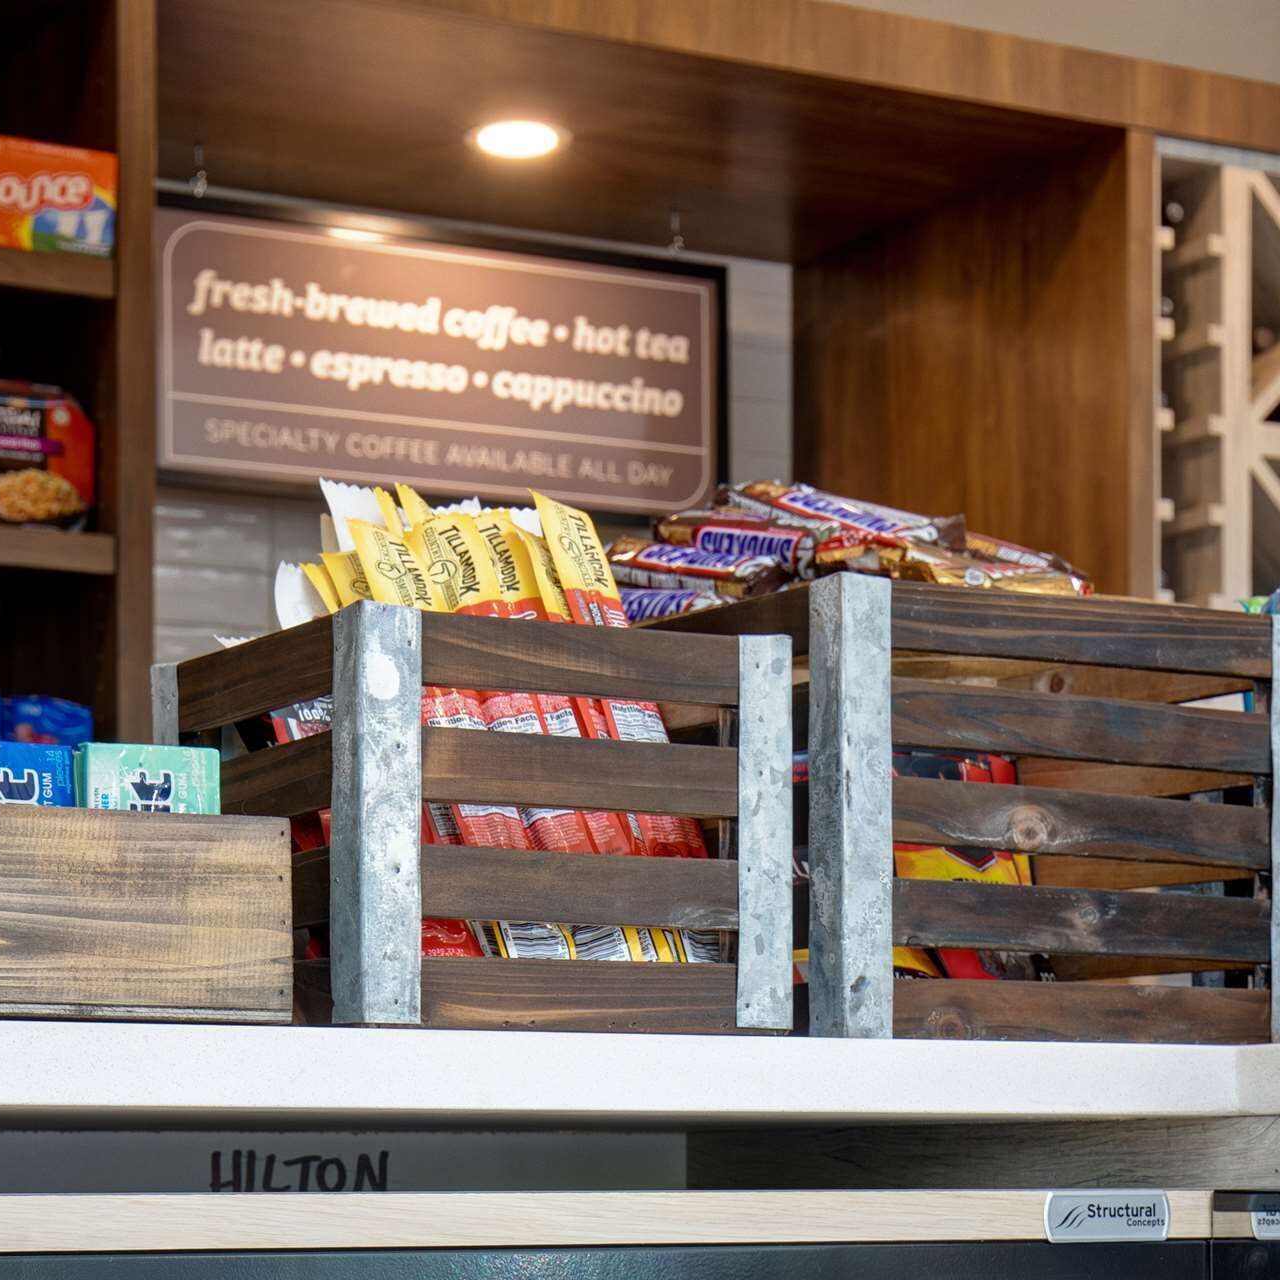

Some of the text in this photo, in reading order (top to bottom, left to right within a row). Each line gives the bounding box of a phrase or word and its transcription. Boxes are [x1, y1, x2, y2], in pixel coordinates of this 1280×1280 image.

[188, 269, 690, 364] fresh-brewed coffee hot tea
[198, 328, 683, 419] latte espresso cappuccino
[204, 416, 674, 487] SPECIALTY COFFEE AVAILABLE ALL DAY
[440, 525, 480, 596] TILLAMOOK
[480, 524, 519, 592] TILLAMOOK
[568, 514, 608, 589] TILLAMOOK
[42, 773, 53, 799] GUM
[210, 1149, 389, 1192] HILTON
[1087, 1203, 1156, 1220] Structural
[1127, 1216, 1166, 1228] Concepts
